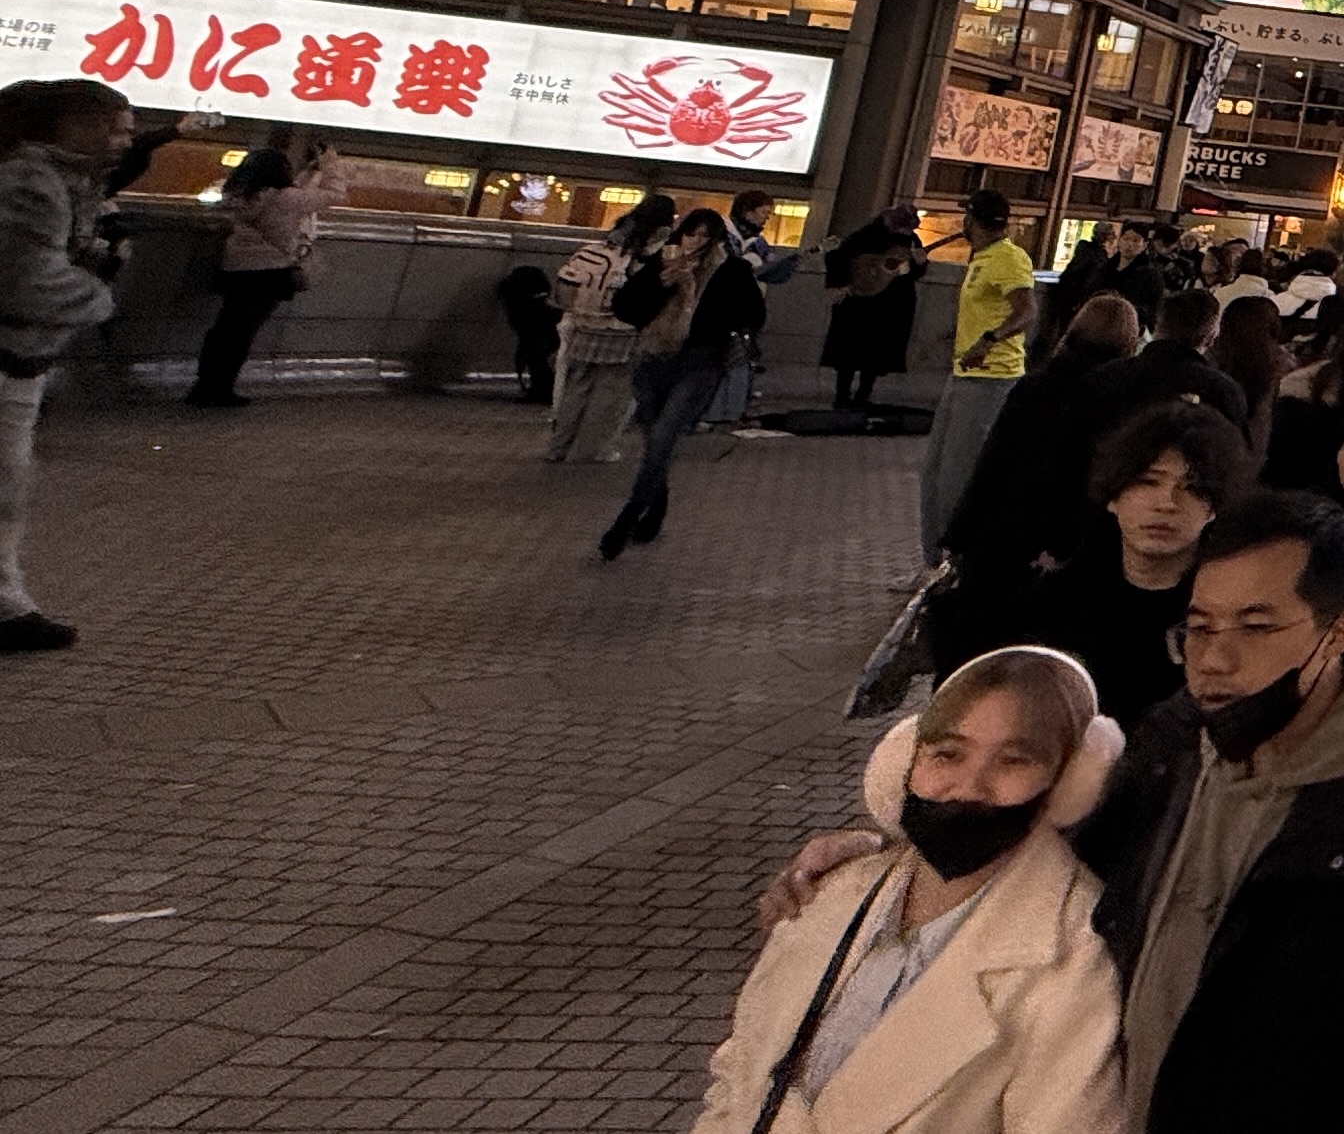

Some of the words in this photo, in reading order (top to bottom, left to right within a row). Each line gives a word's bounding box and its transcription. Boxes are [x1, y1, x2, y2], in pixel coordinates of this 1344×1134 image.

[513, 72, 574, 91] おいしさ
[510, 87, 571, 106] 年中無休
